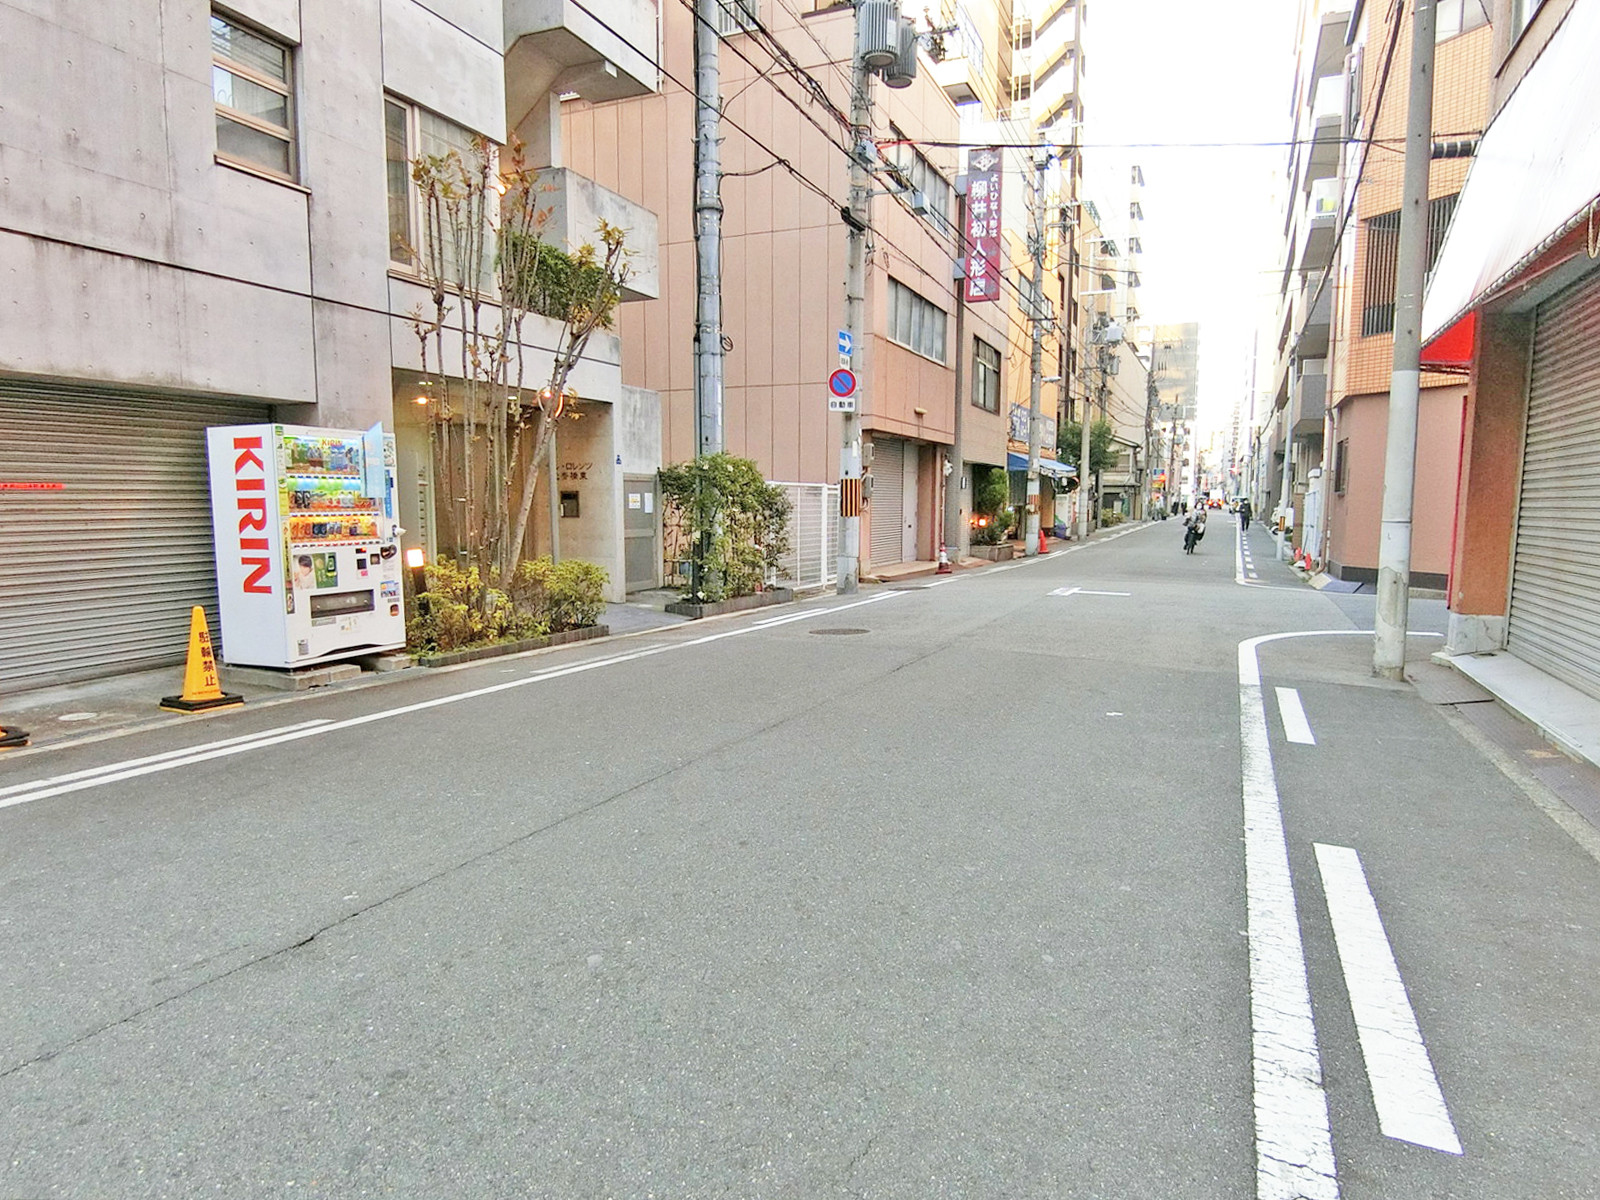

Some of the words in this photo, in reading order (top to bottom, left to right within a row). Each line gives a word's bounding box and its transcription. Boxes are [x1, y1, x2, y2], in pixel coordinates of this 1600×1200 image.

[233, 436, 272, 595] KIRIN
[198, 631, 217, 686] 駐輪禁止
